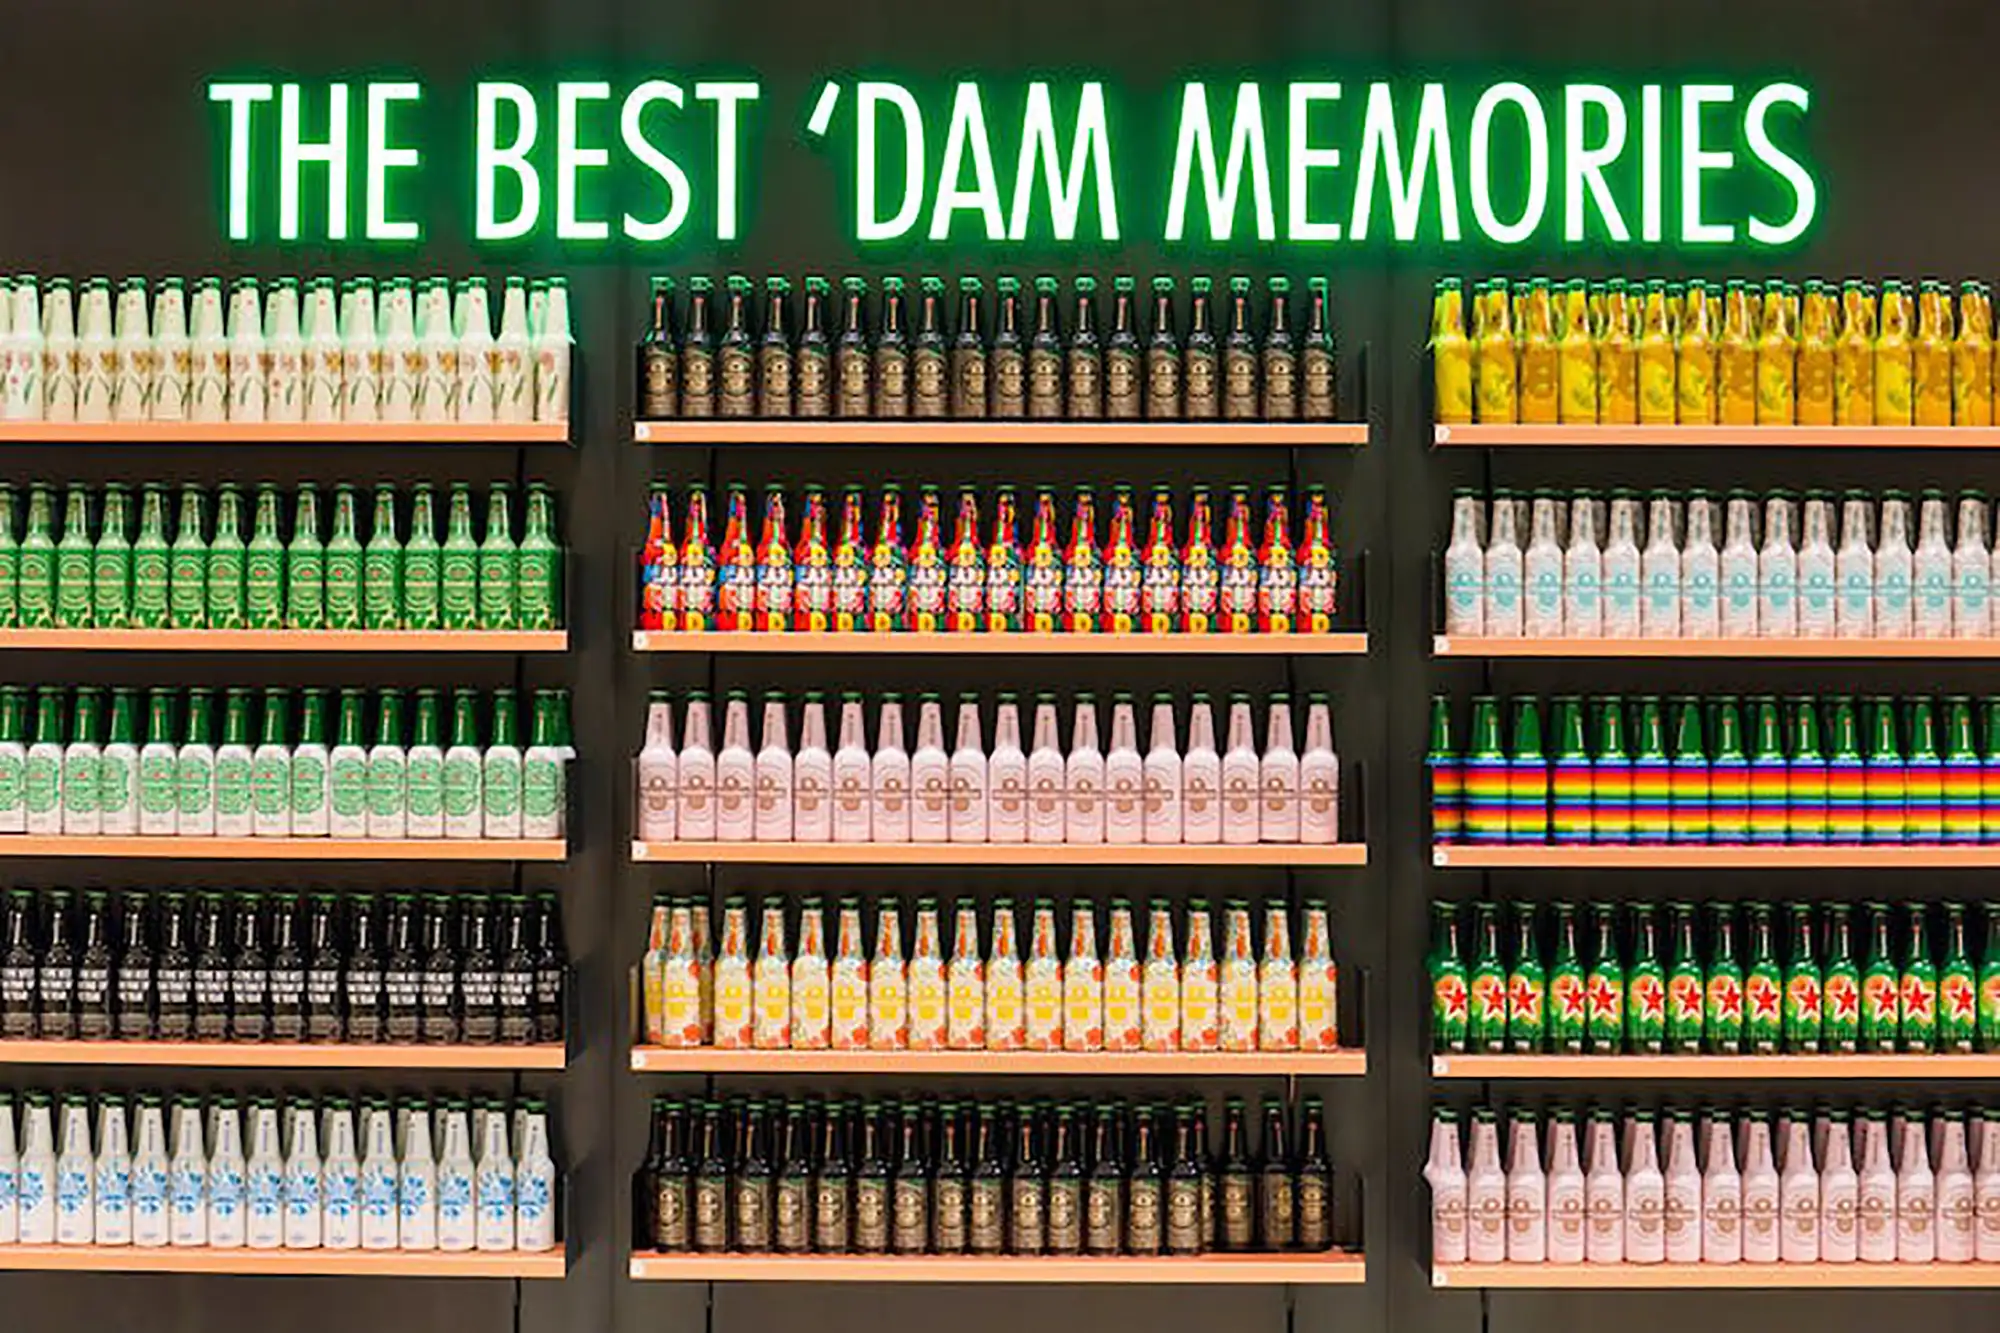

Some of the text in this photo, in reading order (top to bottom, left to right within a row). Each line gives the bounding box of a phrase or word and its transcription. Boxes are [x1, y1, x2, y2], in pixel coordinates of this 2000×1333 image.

[210, 83, 419, 239] THE
[477, 82, 759, 241] BEST
[1165, 82, 1815, 243] MEMORIES
